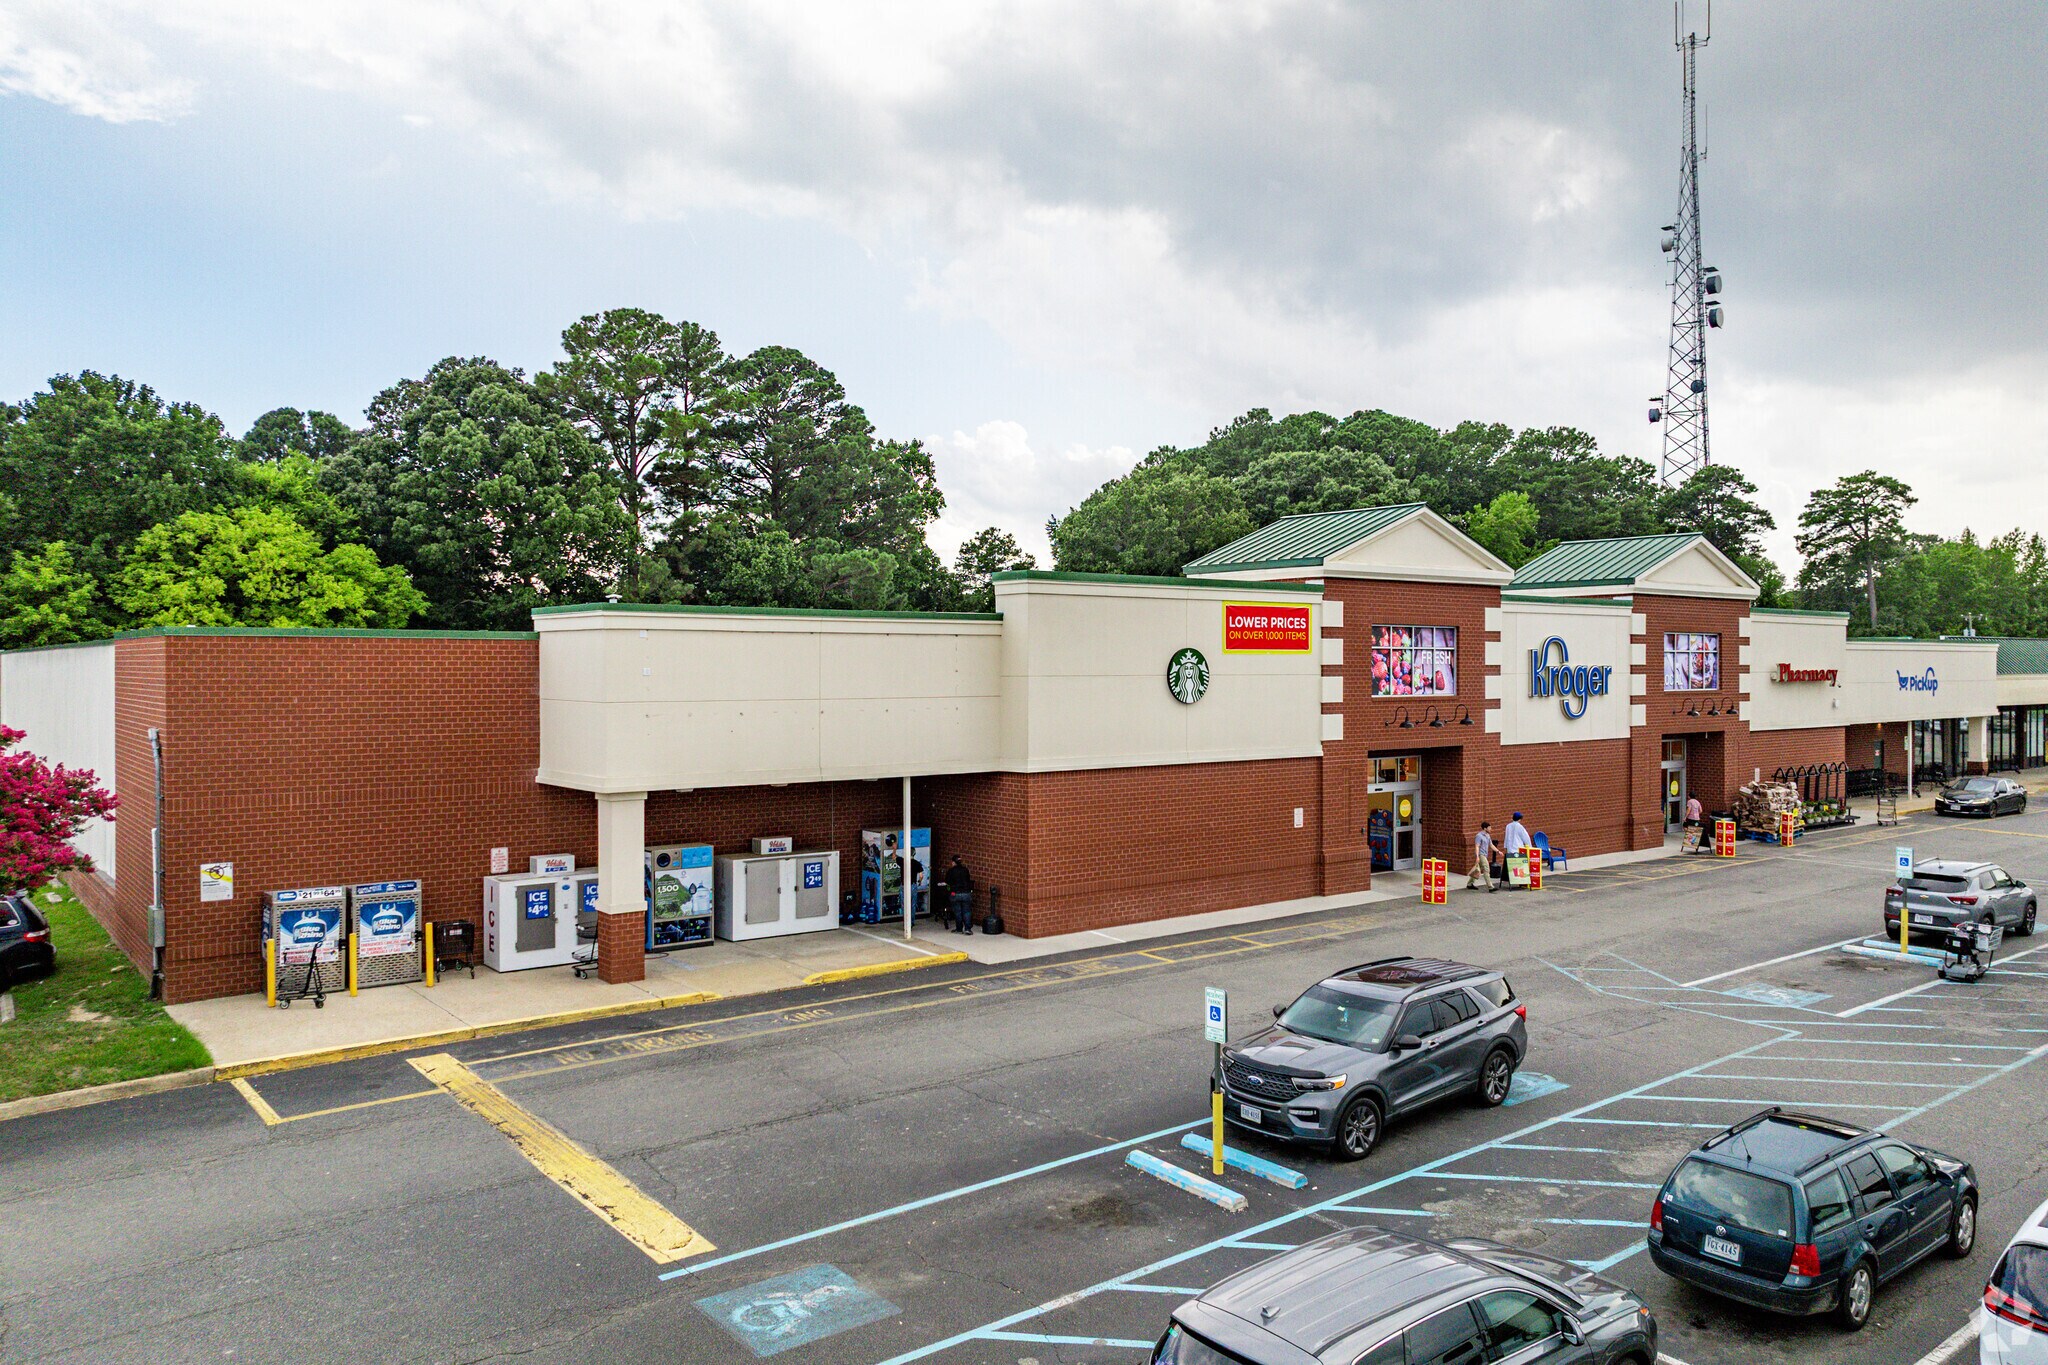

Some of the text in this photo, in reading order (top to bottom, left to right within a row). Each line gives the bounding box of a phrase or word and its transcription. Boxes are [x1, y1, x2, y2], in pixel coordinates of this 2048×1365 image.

[1229, 616, 1307, 629] LOWER PRICES
[1229, 631, 1307, 641] ON OVER 1,000 ITEMS
[1421, 651, 1451, 665] FRESH
[1529, 635, 1613, 719] Kroger
[1774, 663, 1839, 687] Pharmacy
[806, 864, 821, 873] ICE
[586, 885, 597, 895] IC
[657, 884, 679, 893] 1,500
[529, 891, 547, 902] ICE
